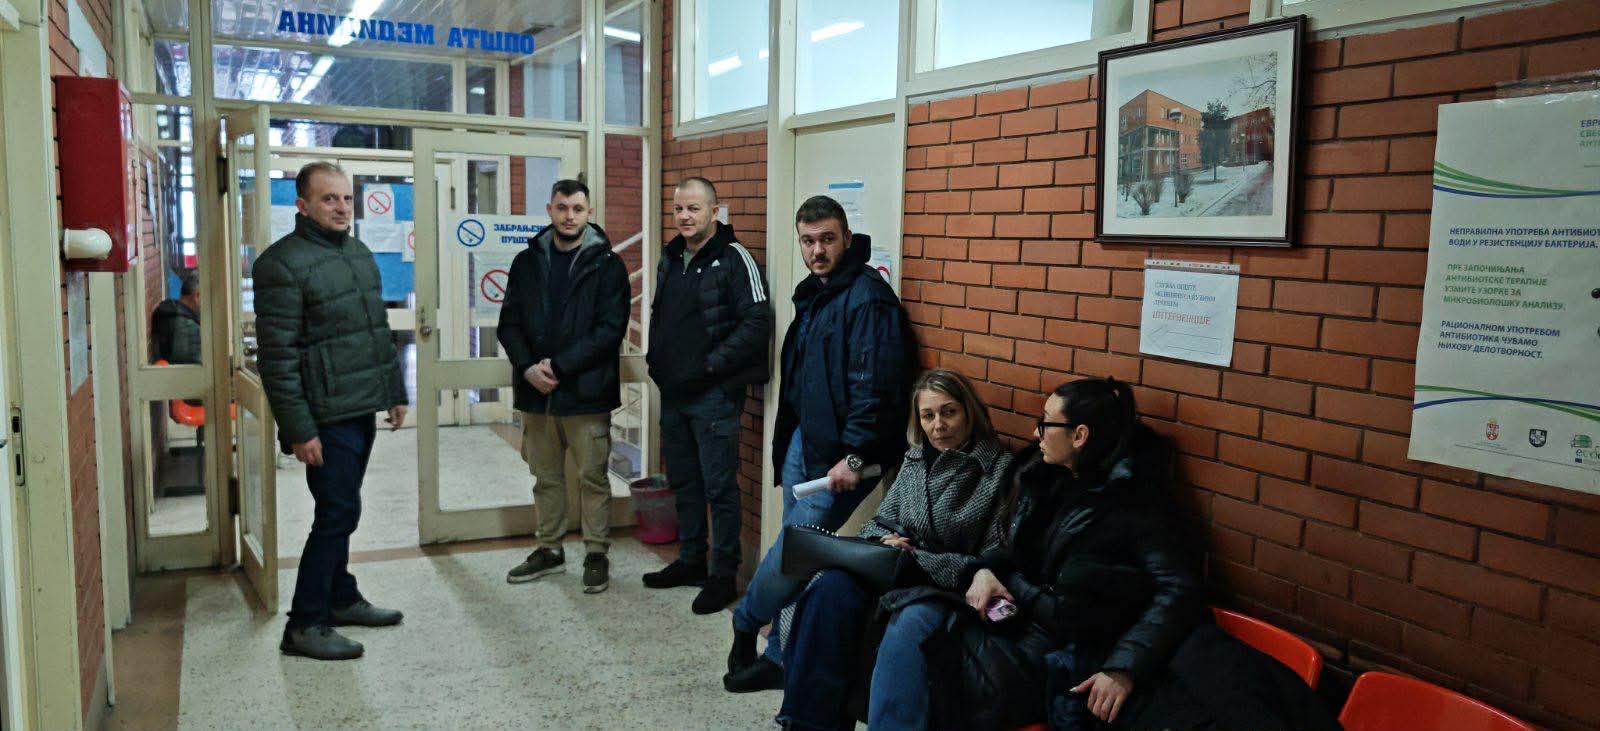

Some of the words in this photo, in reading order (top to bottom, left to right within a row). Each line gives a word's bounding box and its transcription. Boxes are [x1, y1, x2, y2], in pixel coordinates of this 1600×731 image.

[1450, 227, 1503, 236] НЕПРАВИЛНА
[1505, 228, 1550, 237] УПОТРЕБА
[1449, 238, 1472, 247] ВОДИ
[1472, 239, 1478, 247] У
[1480, 239, 1543, 248] РЕЗИСТЕНЦИЈУ
[1545, 239, 1598, 249] БАКТЕРИЈА.
[1447, 264, 1463, 272] ПРЕ
[1464, 264, 1525, 273] ЗАПОЧИЊАЊА
[1445, 275, 1504, 285] АНТИБИОТСКЕ
[1506, 277, 1548, 286] ТЕРАПИЈЕ
[1444, 285, 1477, 294] УЗМИТЕ
[1477, 286, 1509, 295] УЗОРКЕ
[1510, 288, 1522, 296] ЗА
[1443, 295, 1520, 307] МИКРОБИОЛОШКУ
[1441, 320, 1505, 333] РАЦИОНАЛНОМ
[1506, 326, 1560, 337] УПОТРЕБОМ
[1439, 331, 1500, 343] АНТИБИОТИКА
[1501, 336, 1538, 347] ЧУВАМО
[1437, 342, 1472, 352] ЊИХОВУ
[1473, 345, 1543, 359] ДЕЛОТВОРНОСТ.
